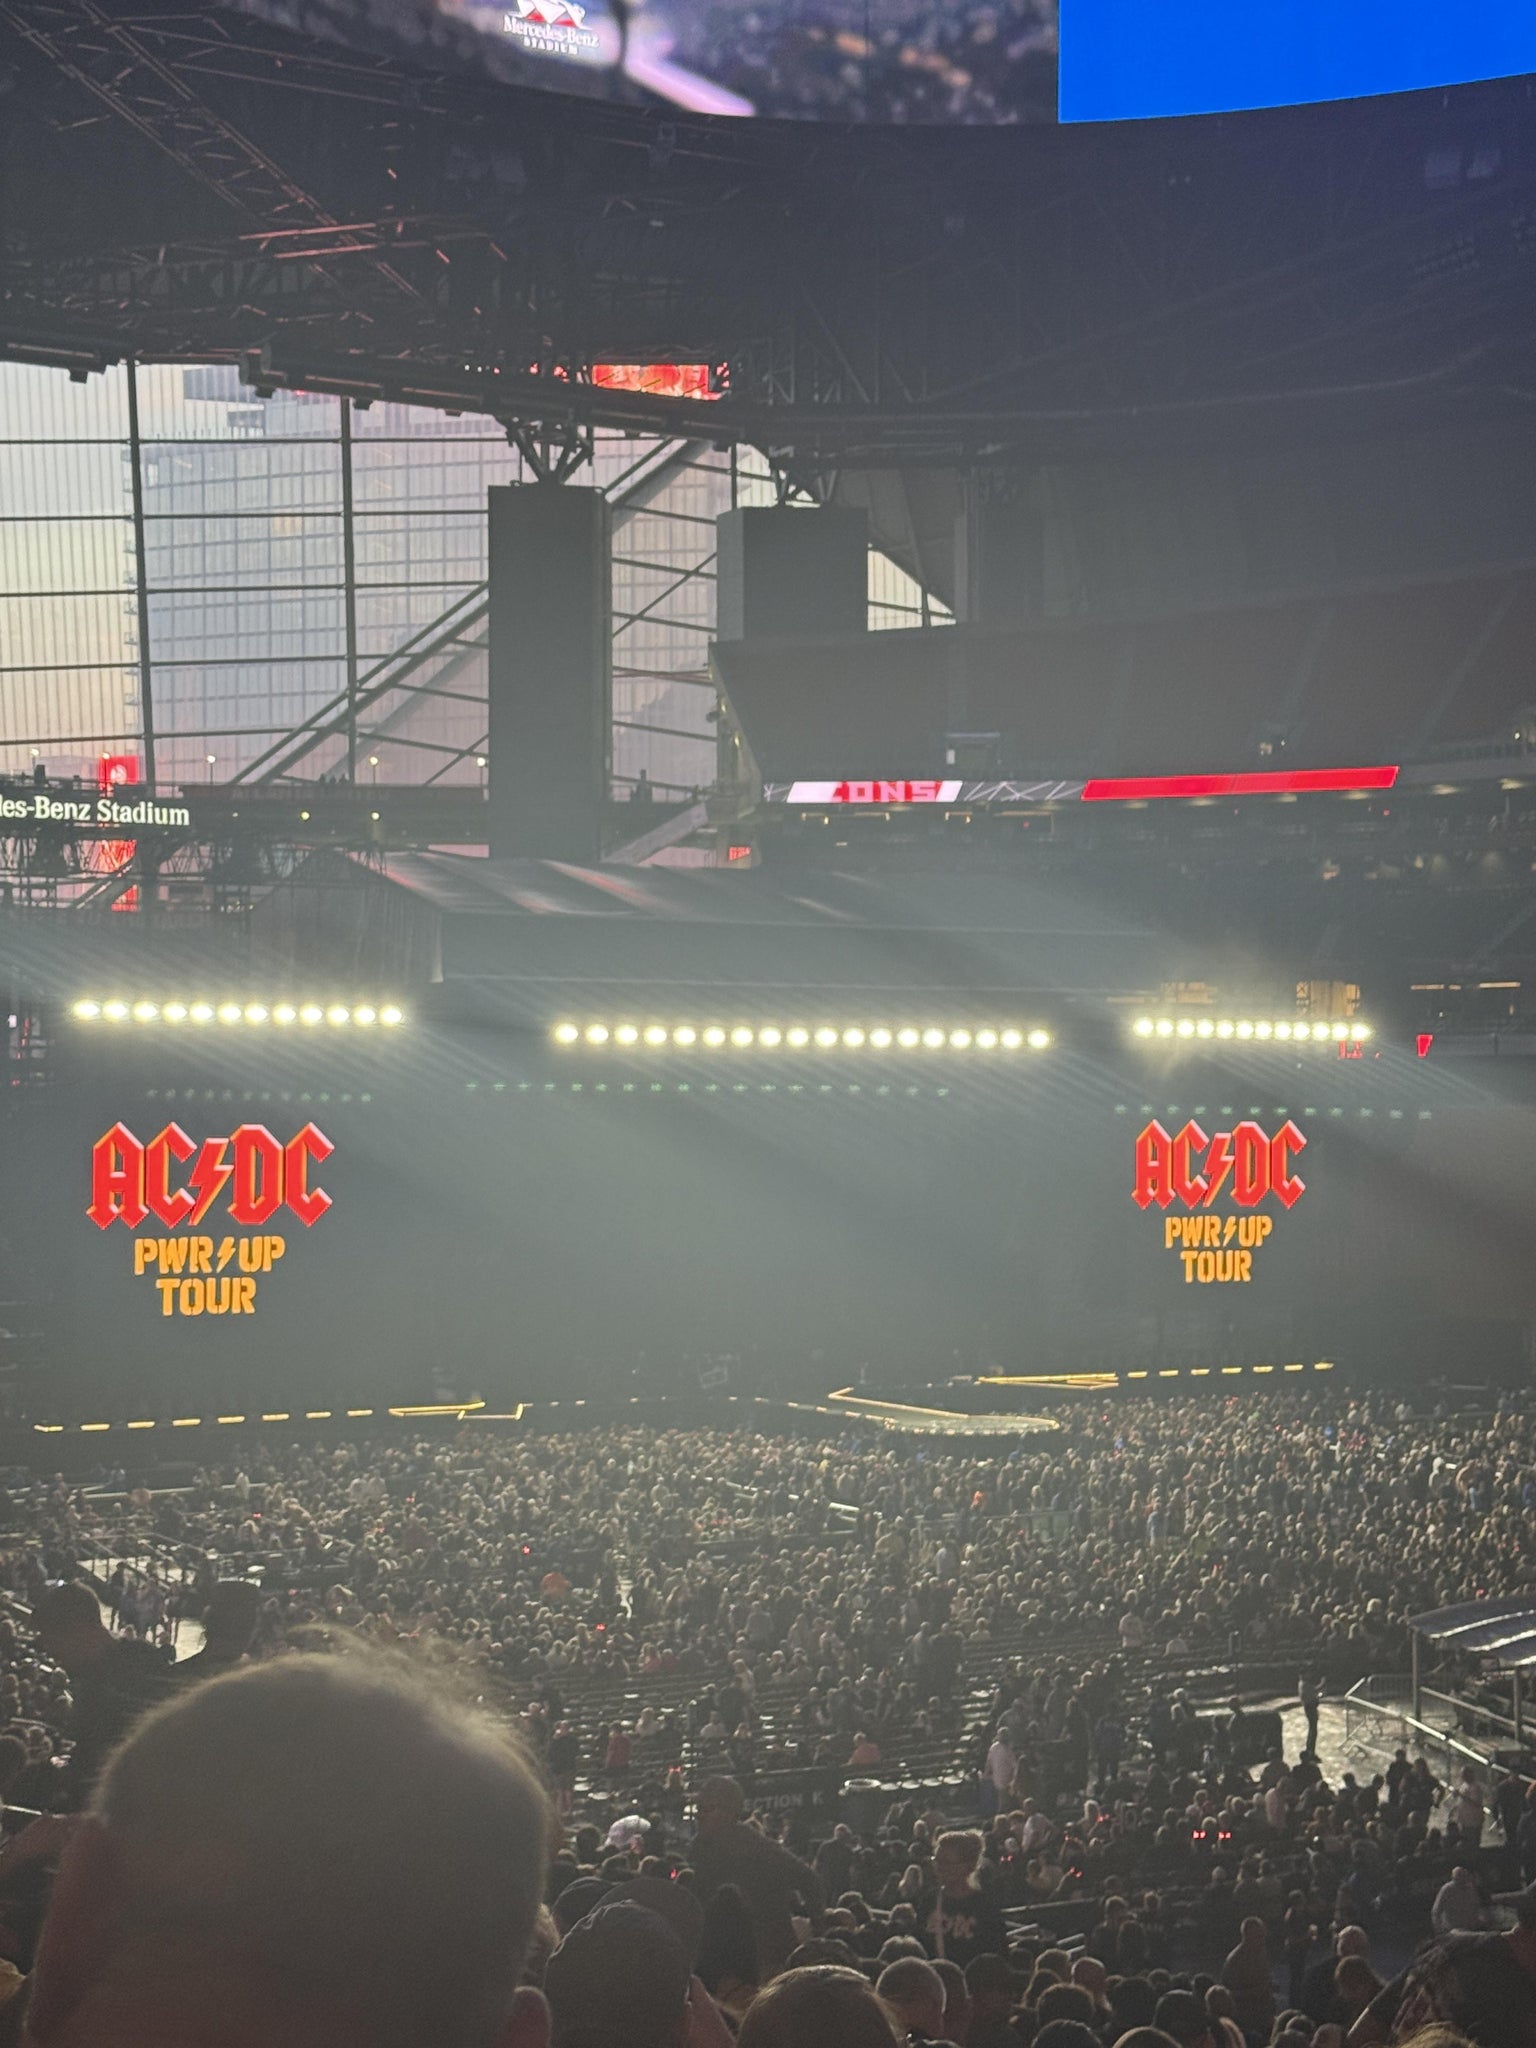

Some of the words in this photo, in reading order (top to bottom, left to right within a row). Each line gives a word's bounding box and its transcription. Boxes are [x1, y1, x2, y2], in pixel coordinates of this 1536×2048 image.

[503, 14, 600, 48] Mercedes-Benz
[523, 36, 579, 55] STADIUM
[97, 799, 190, 826] Stadium
[1180, 1250, 1253, 1283] TOUR
[155, 1277, 258, 1317] TOUR
[743, 1793, 803, 1812] ECTION
